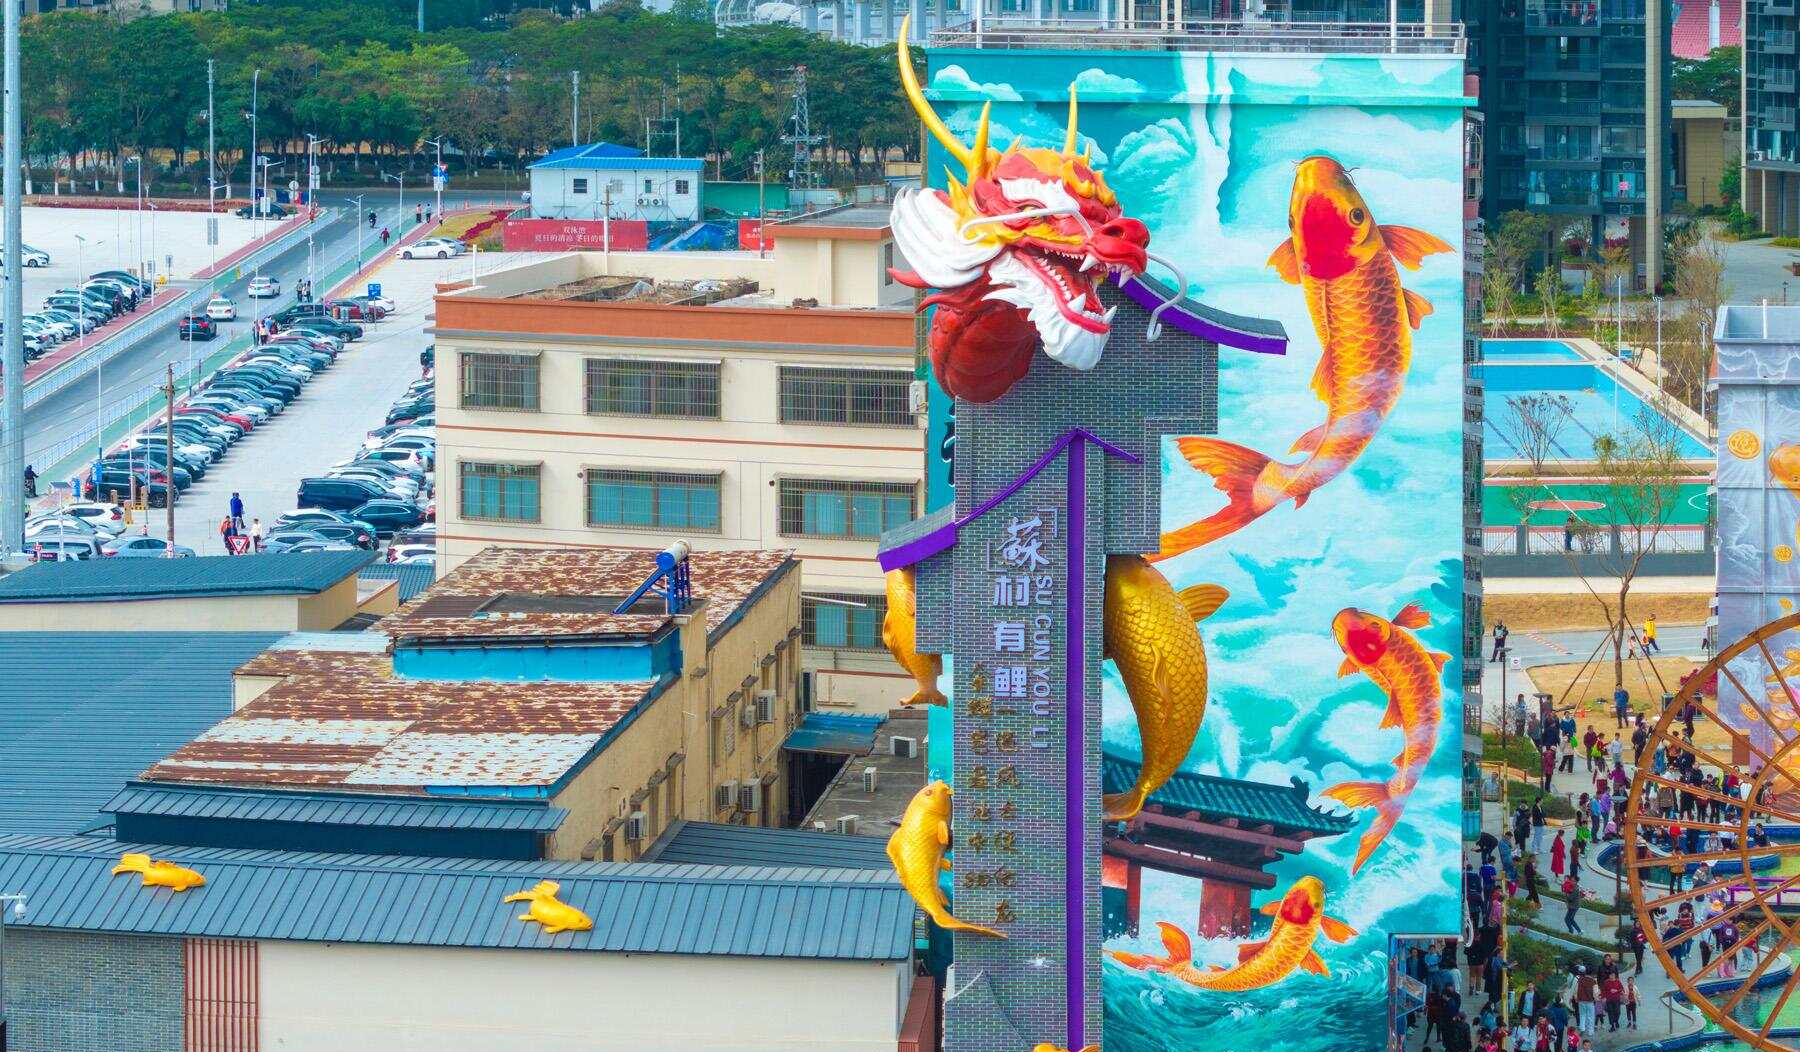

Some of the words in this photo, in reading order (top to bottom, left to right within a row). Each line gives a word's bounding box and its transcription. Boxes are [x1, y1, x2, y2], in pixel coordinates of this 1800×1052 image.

[1034, 575, 1052, 606] SU
[1033, 616, 1051, 661] CUN
[1032, 667, 1050, 716] YOU
[1031, 727, 1049, 748] LI
